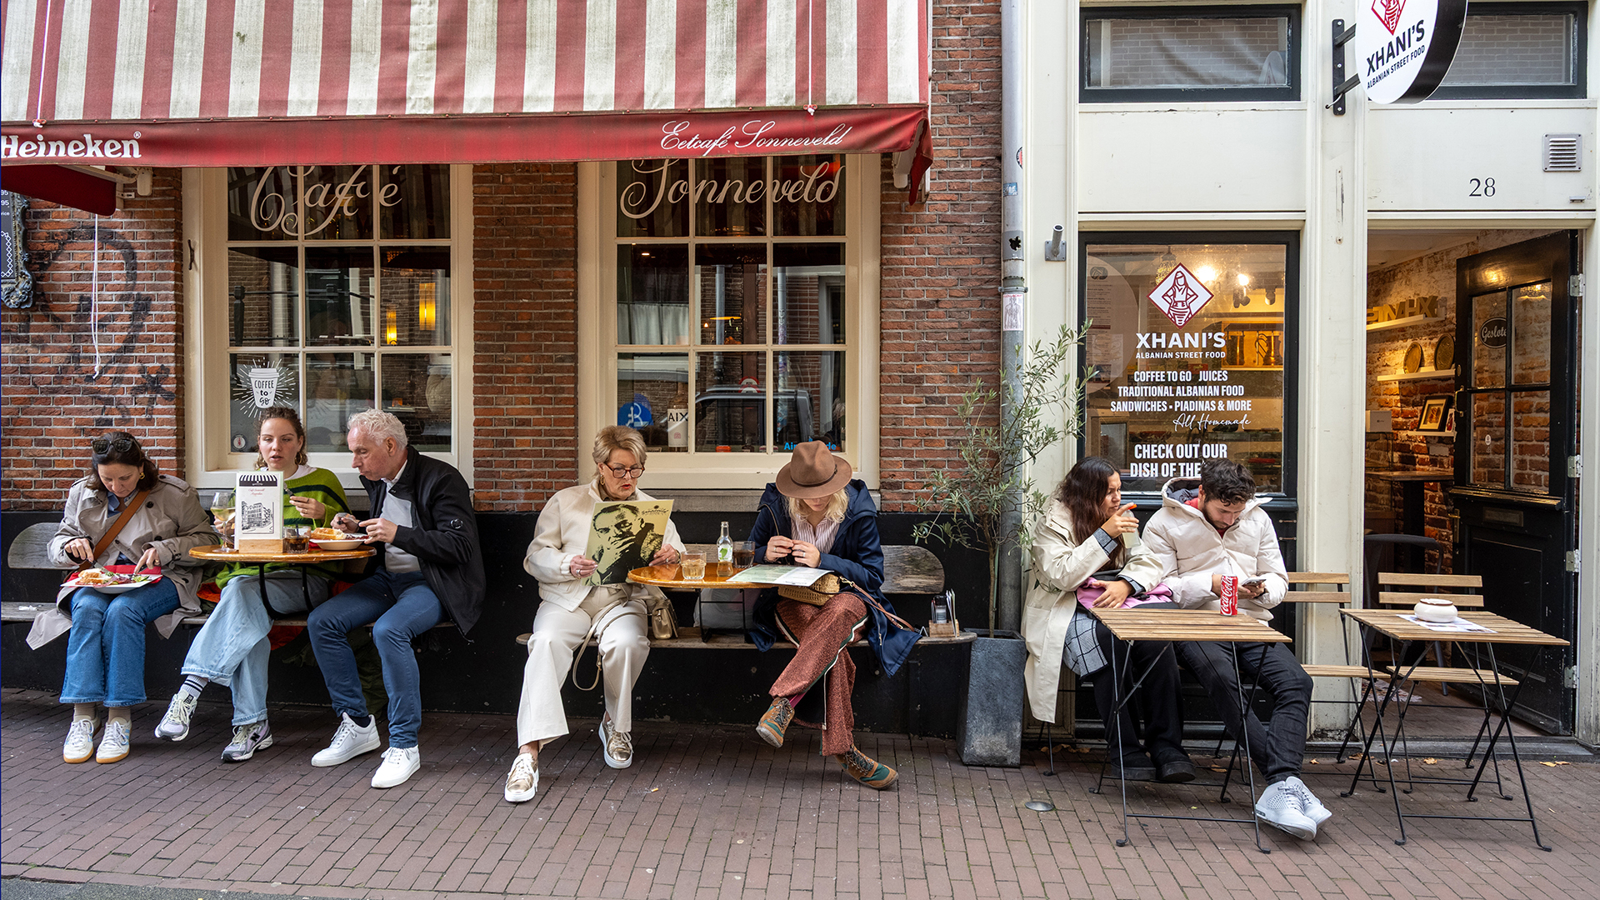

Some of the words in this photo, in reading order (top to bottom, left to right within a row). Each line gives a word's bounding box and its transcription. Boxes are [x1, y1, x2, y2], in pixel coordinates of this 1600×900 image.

[1366, 19, 1425, 77] XHANI'S
[1367, 68, 1390, 89] ALBANIAN
[1390, 55, 1409, 74] STREET
[1410, 45, 1425, 61] FOOD
[660, 121, 736, 156] Eetcafé
[734, 120, 852, 148] Sonneveld
[620, 158, 846, 219] Sonneveld
[1469, 177, 1496, 197] 28
[251, 165, 403, 237] Café
[1135, 332, 1226, 349] XHANI'S
[1136, 351, 1173, 359] ALBANIAN
[1175, 351, 1203, 359] STREET
[1205, 351, 1226, 359] FOOD
[254, 380, 274, 389] COFFEE
[1134, 370, 1167, 382] COFFEE
[1167, 370, 1178, 382] TO
[1179, 370, 1192, 382] GO
[1199, 370, 1228, 382] JUICES
[1118, 385, 1174, 397] TRADITIONAL
[1176, 385, 1220, 397] ALBANIAN
[1221, 385, 1245, 397] FOOD
[1110, 400, 1168, 412] SANDWICHES
[1174, 400, 1216, 412] PIADINAS
[1217, 400, 1225, 411] &
[1227, 400, 1252, 411] MORE
[1173, 413, 1196, 432] All
[1197, 413, 1251, 430] Homemade
[1134, 444, 1174, 459] CHECK
[1176, 444, 1200, 459] OUT
[1202, 444, 1228, 459] OUR
[1130, 462, 1159, 478] DISH
[1161, 462, 1177, 478] OF
[1178, 462, 1202, 478] THE
